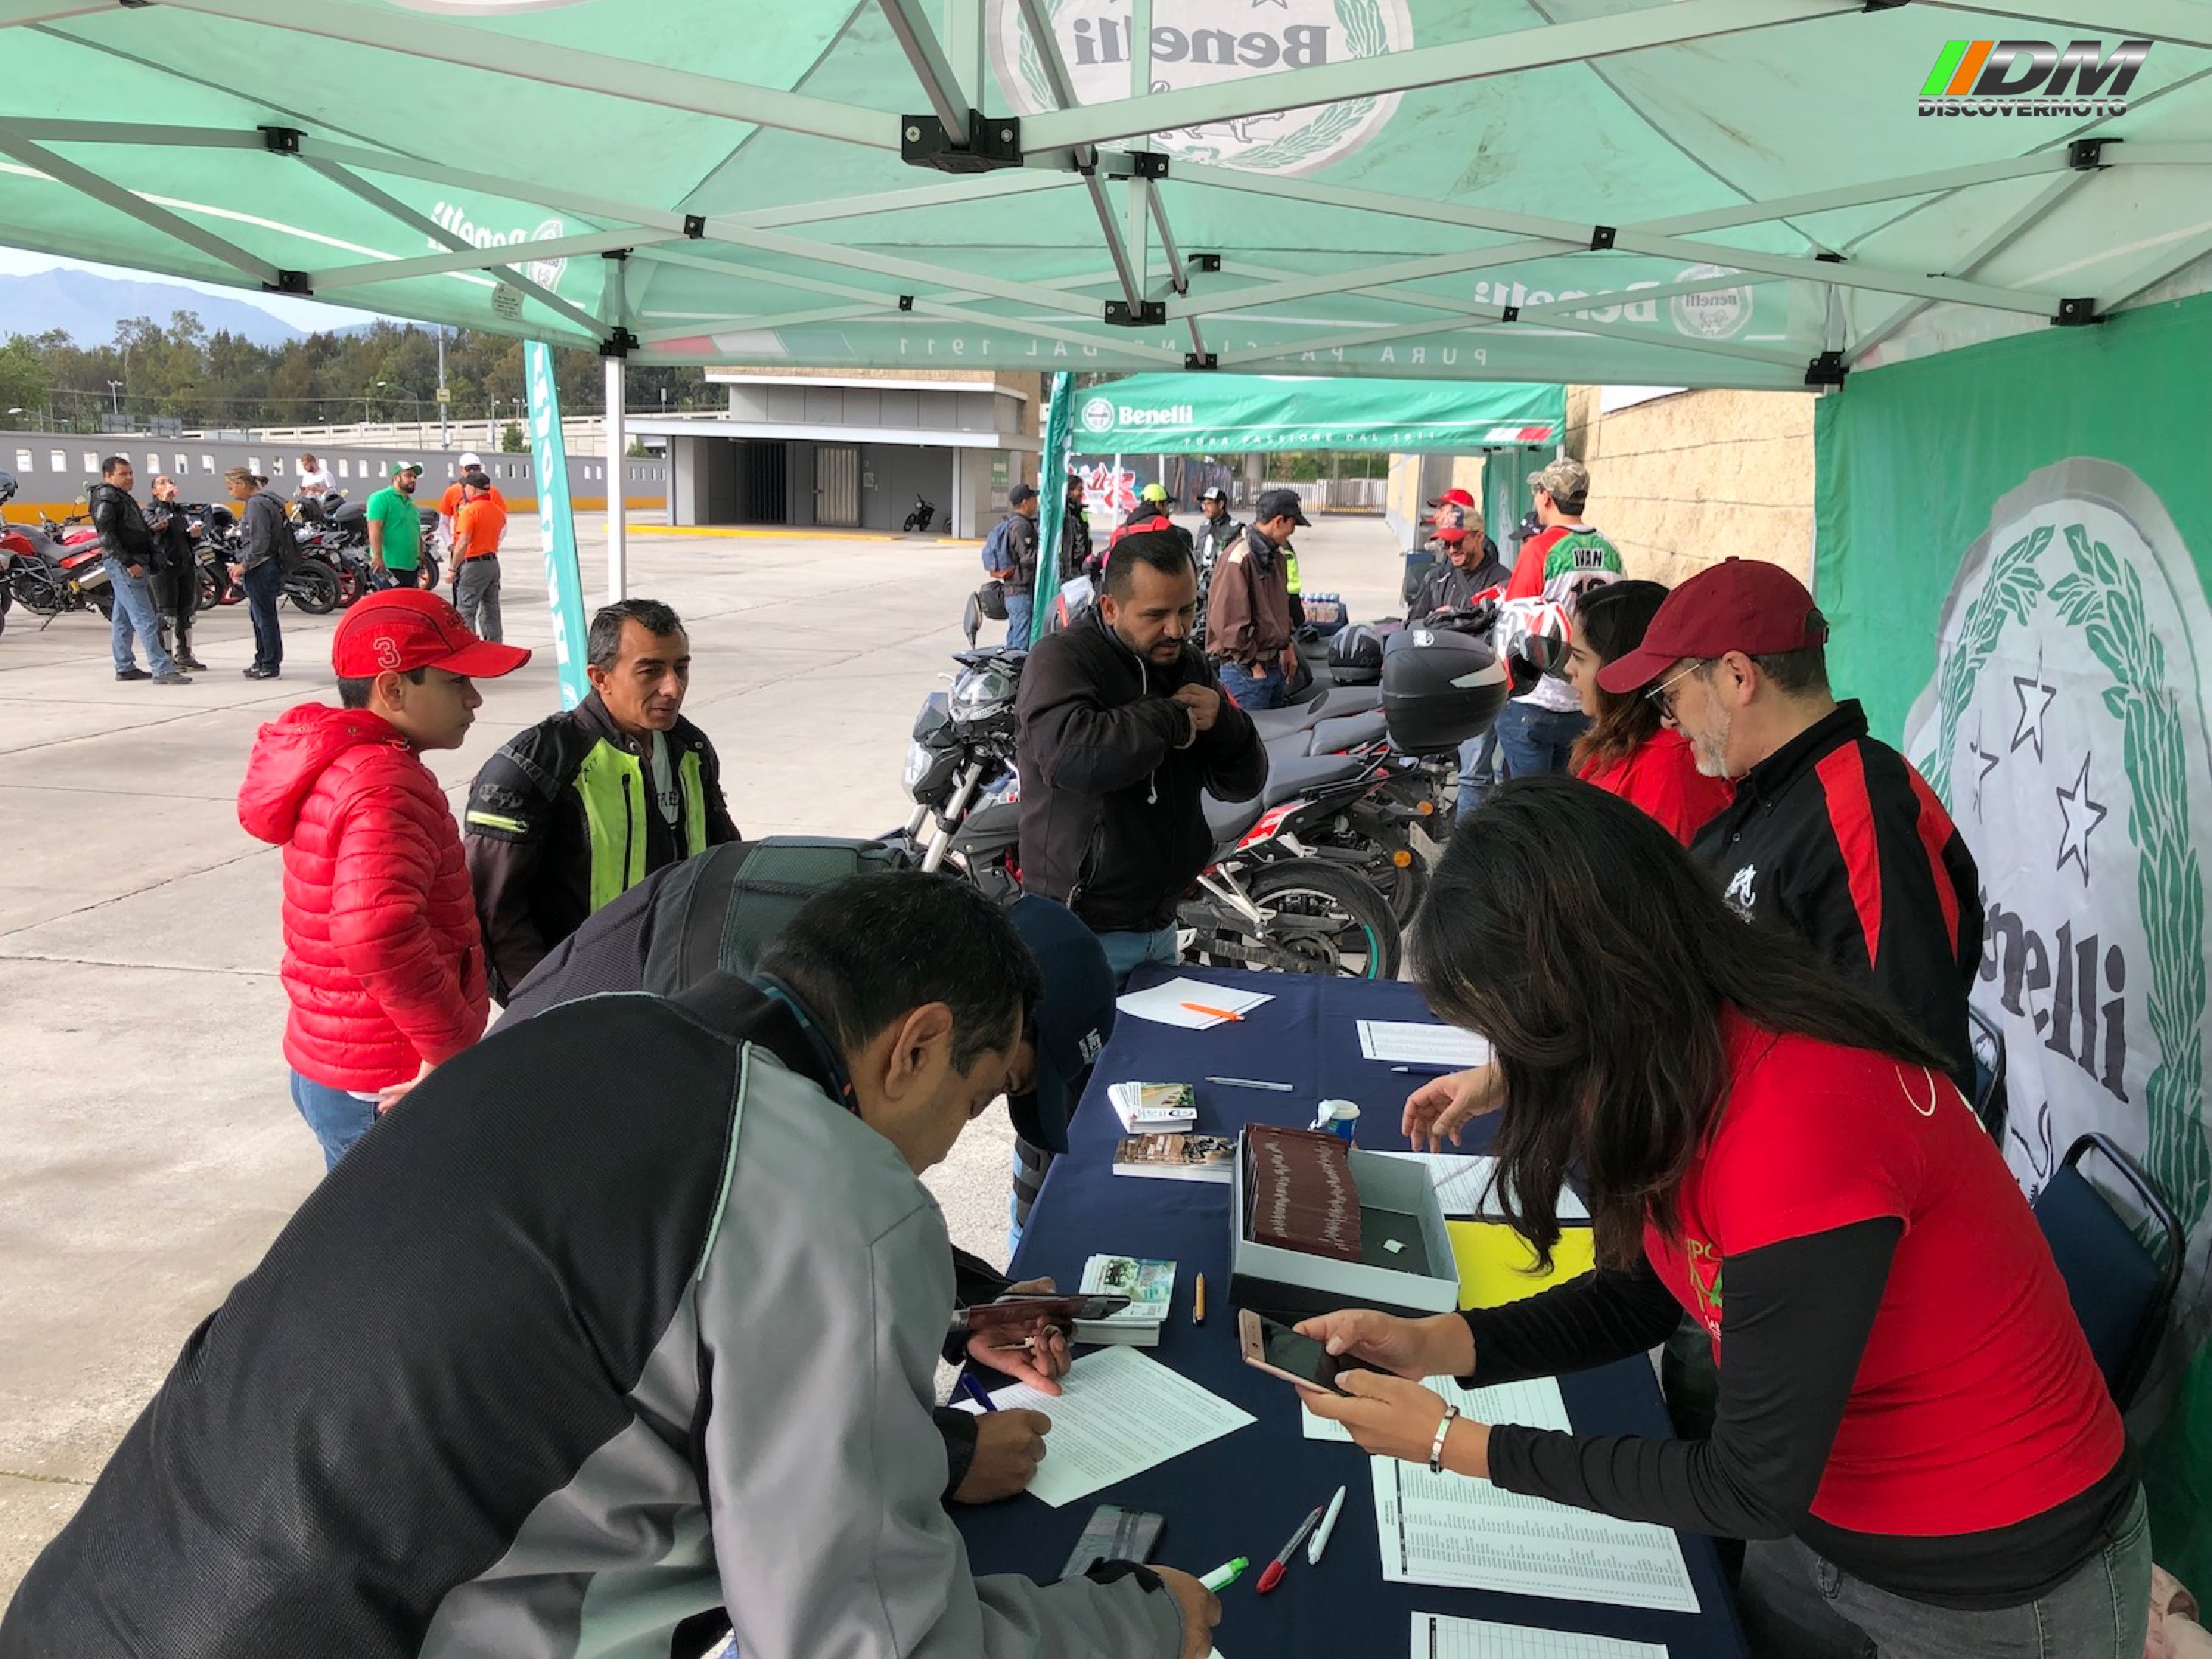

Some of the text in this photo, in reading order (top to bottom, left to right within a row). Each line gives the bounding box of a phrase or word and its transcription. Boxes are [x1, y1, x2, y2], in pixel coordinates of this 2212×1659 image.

[1119, 405, 1193, 425] Benelli
[1573, 549, 1603, 568] IVAN
[373, 636, 401, 668] 3
